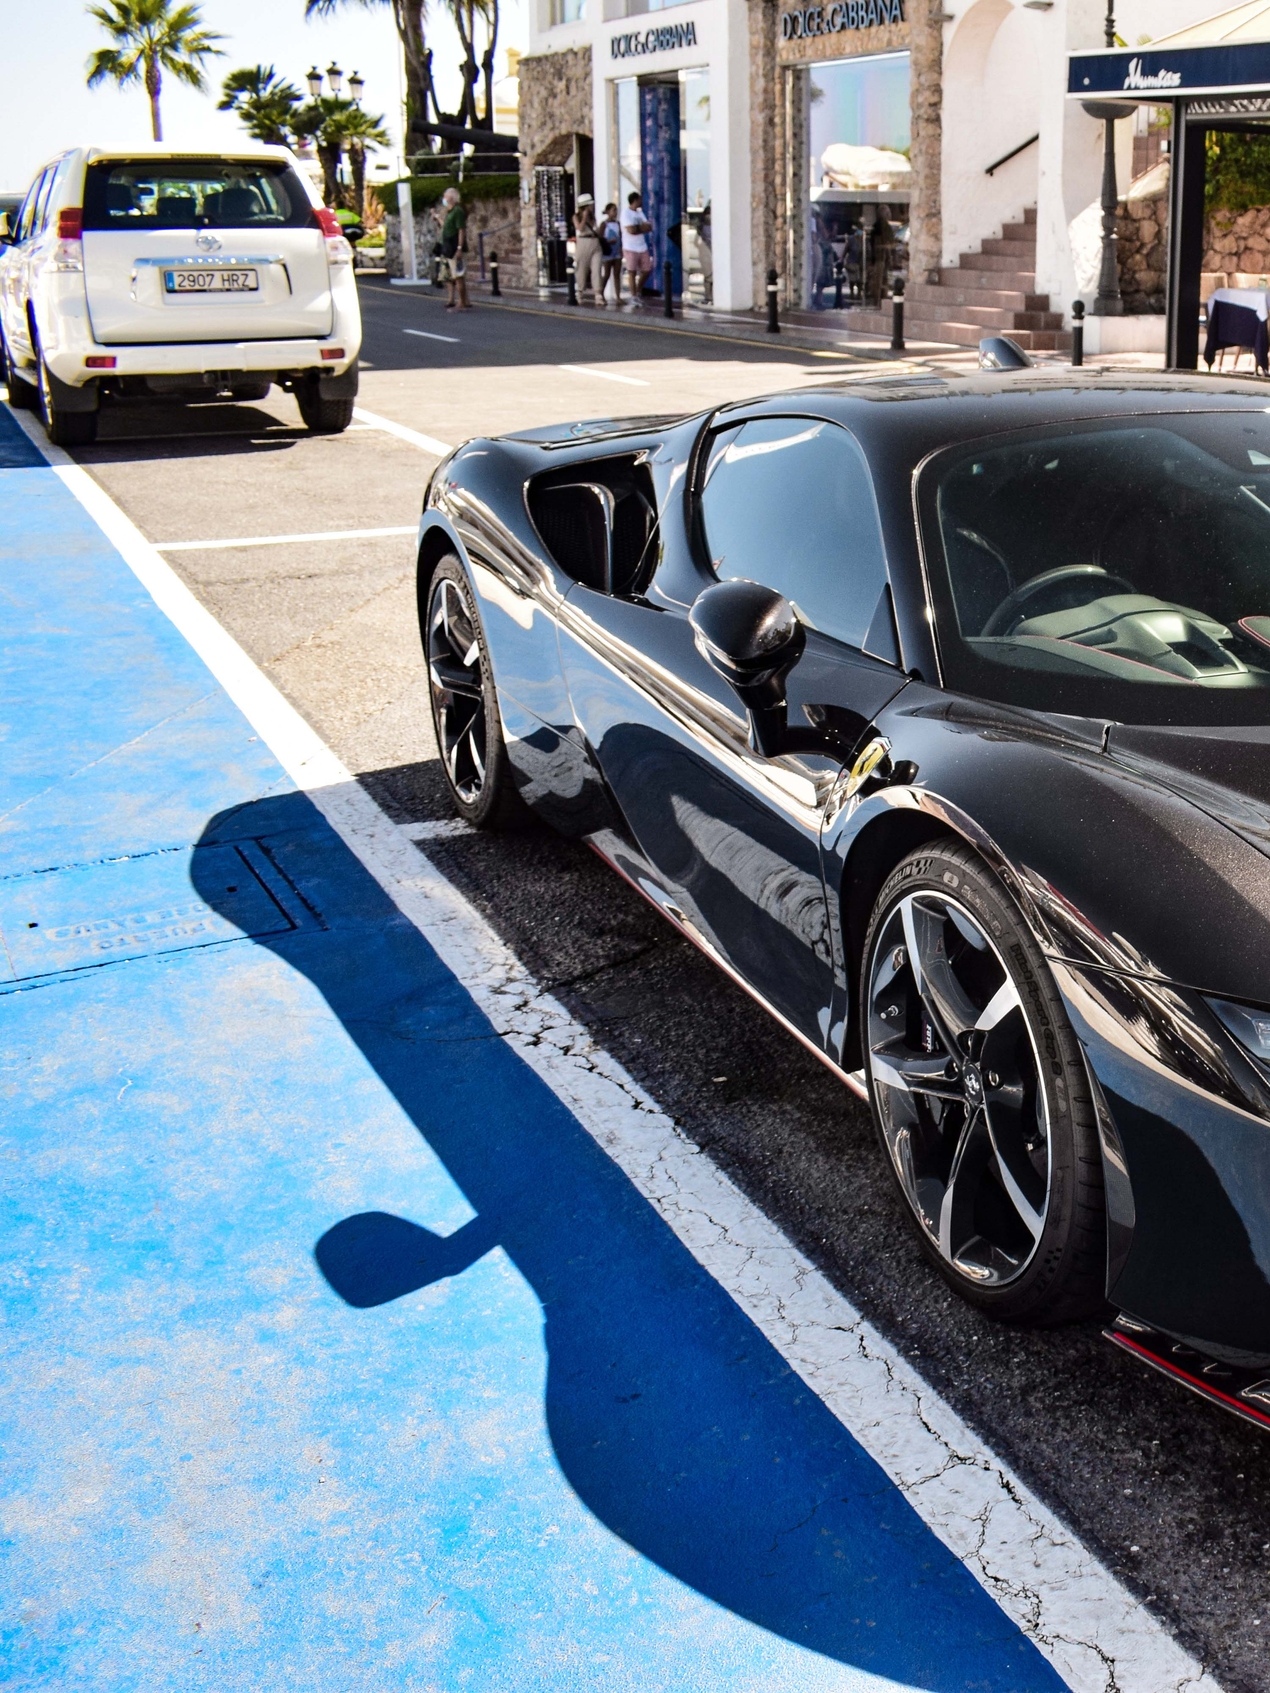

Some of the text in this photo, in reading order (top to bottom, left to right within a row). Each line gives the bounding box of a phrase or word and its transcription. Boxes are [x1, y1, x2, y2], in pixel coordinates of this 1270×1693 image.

[1123, 56, 1182, 90] Mumtaz
[177, 273, 215, 288] 2907
[221, 273, 249, 288] HRZ
